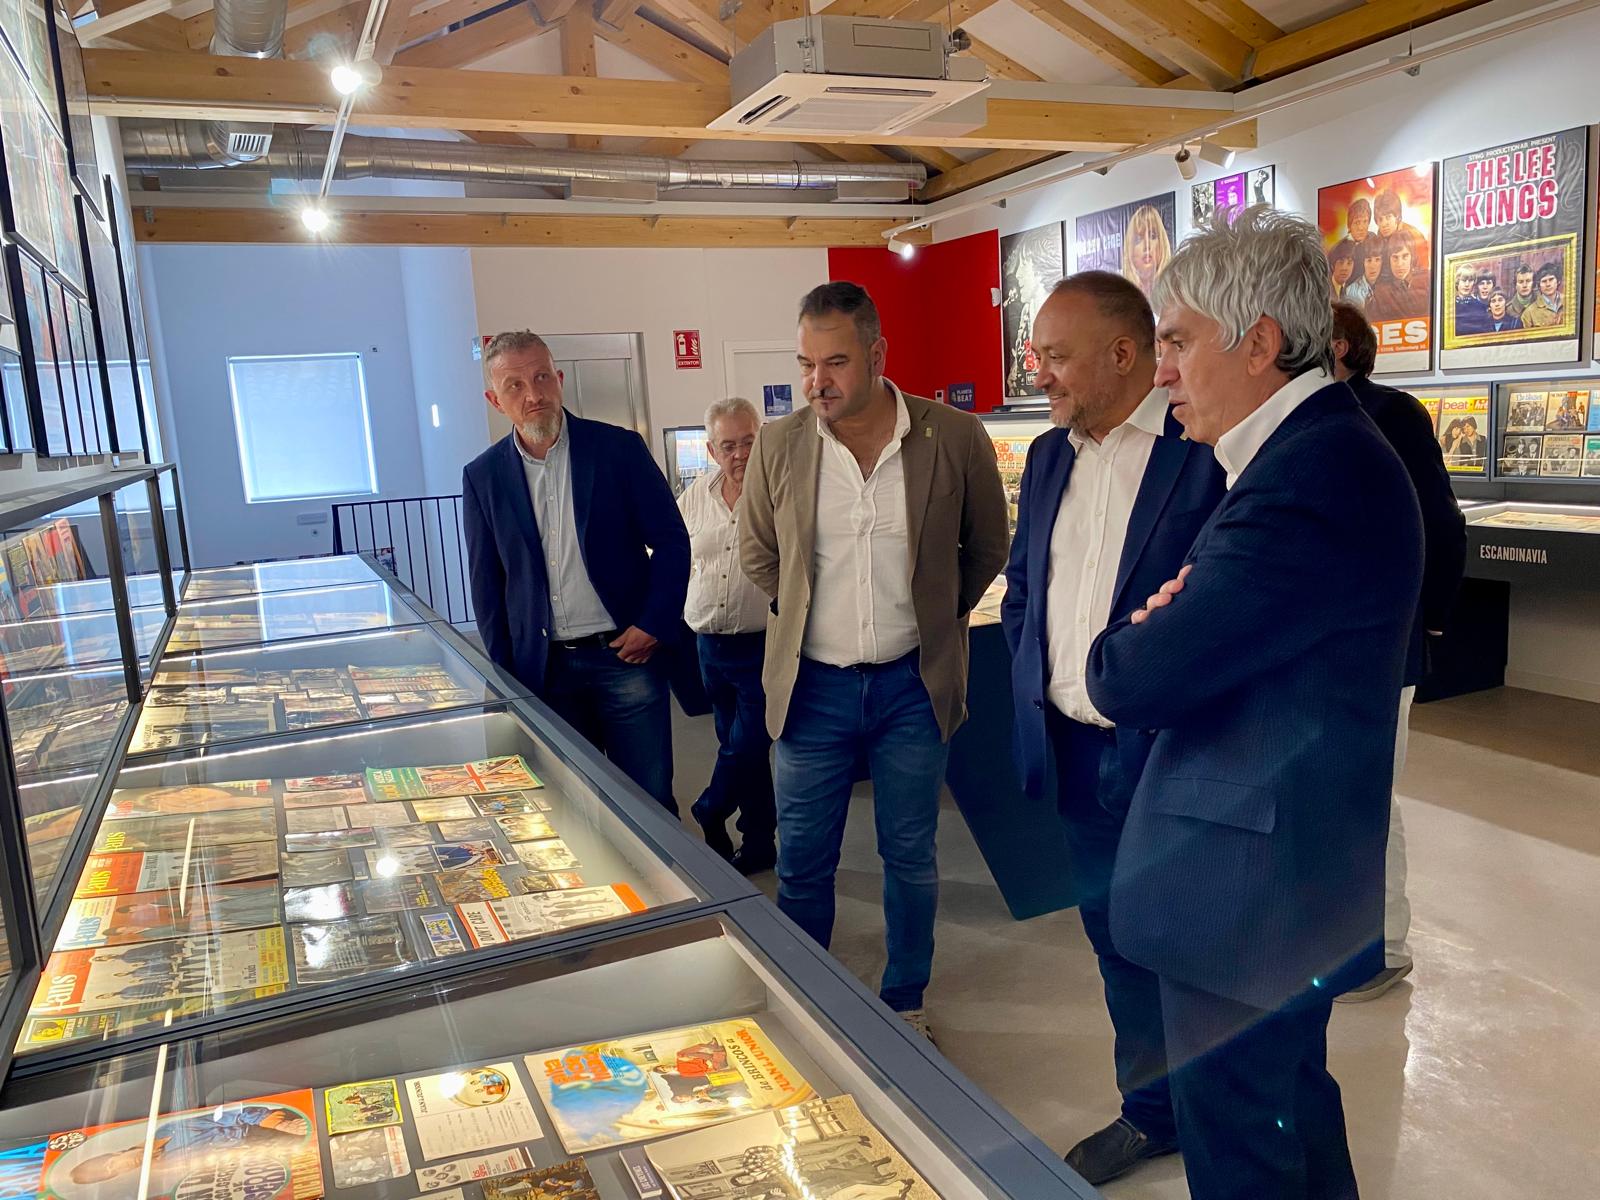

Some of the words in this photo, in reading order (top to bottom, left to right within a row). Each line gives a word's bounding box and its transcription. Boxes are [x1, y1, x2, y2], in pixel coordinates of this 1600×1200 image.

[1486, 144, 1519, 158] PRODUCTION
[1531, 135, 1556, 147] PRESENT
[1465, 155, 1510, 194] THE
[1513, 144, 1556, 184] LEE
[1464, 178, 1558, 231] KINGS
[957, 394, 973, 402] BEAT
[1443, 399, 1469, 410] beat
[1480, 544, 1548, 565] ESCANDINAVIA
[466, 910, 487, 925] CARE
[728, 1045, 765, 1080] BRINCOS
[760, 1081, 773, 1090] de
[49, 1135, 68, 1151] 35
